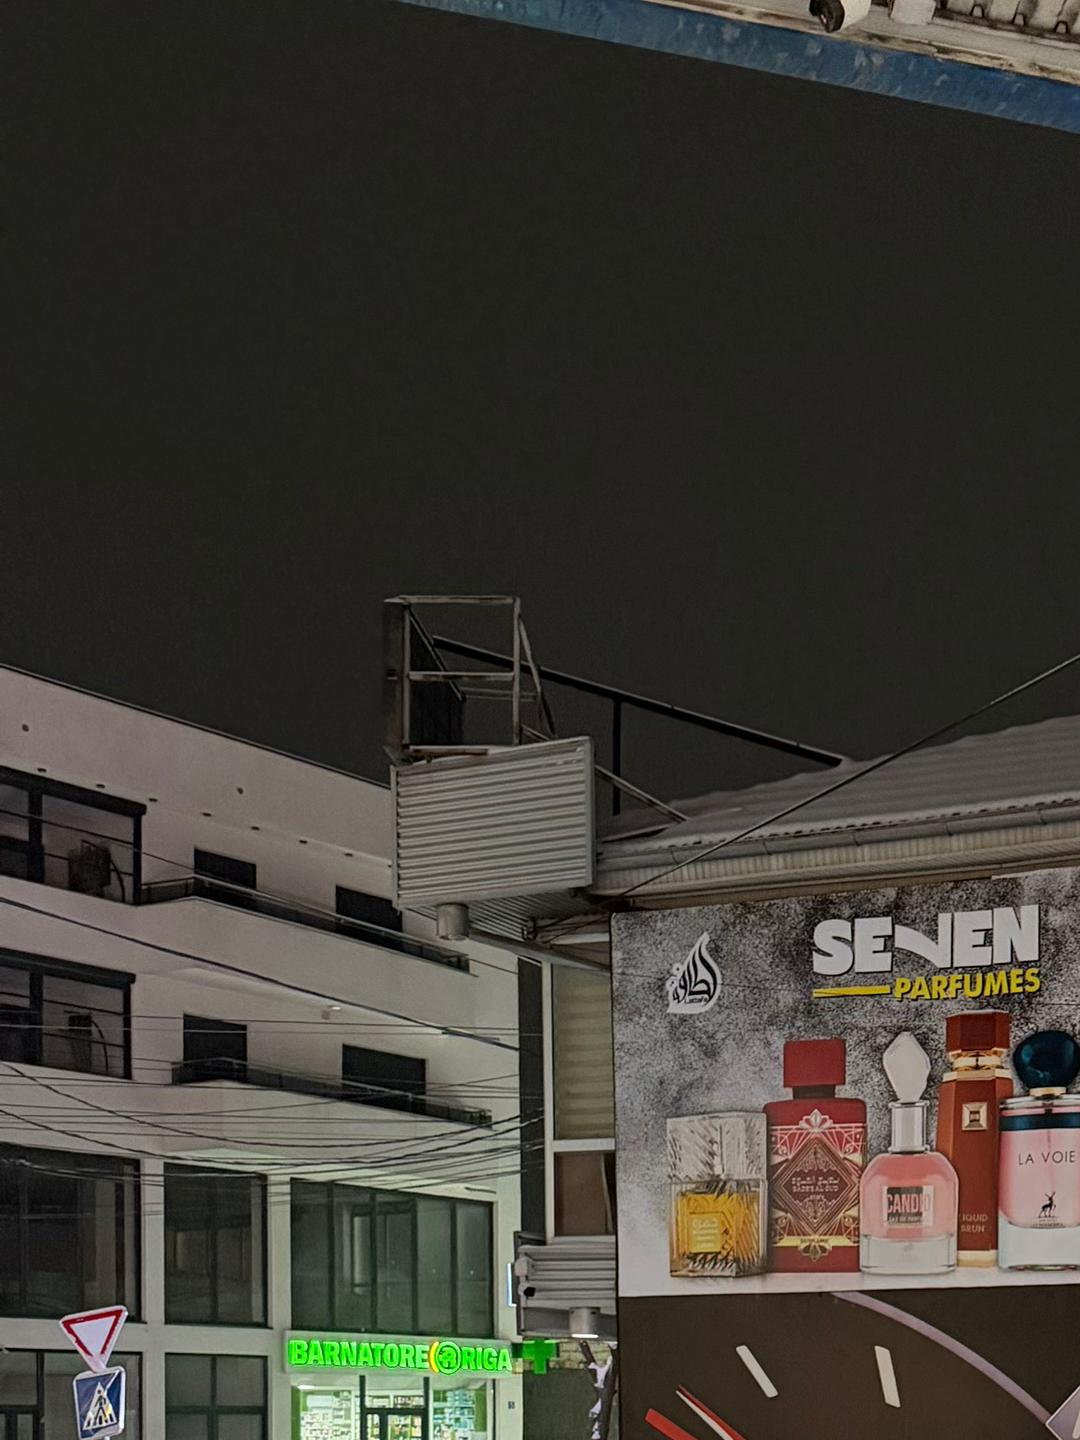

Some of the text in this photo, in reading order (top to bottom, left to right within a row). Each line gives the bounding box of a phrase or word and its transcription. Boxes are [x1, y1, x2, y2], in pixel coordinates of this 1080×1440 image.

[813, 904, 1040, 976] SEVEN
[895, 968, 1041, 1001] PARFUMES
[1018, 1150, 1076, 1166] LA VOIE
[288, 1339, 430, 1370] BARNATORE
